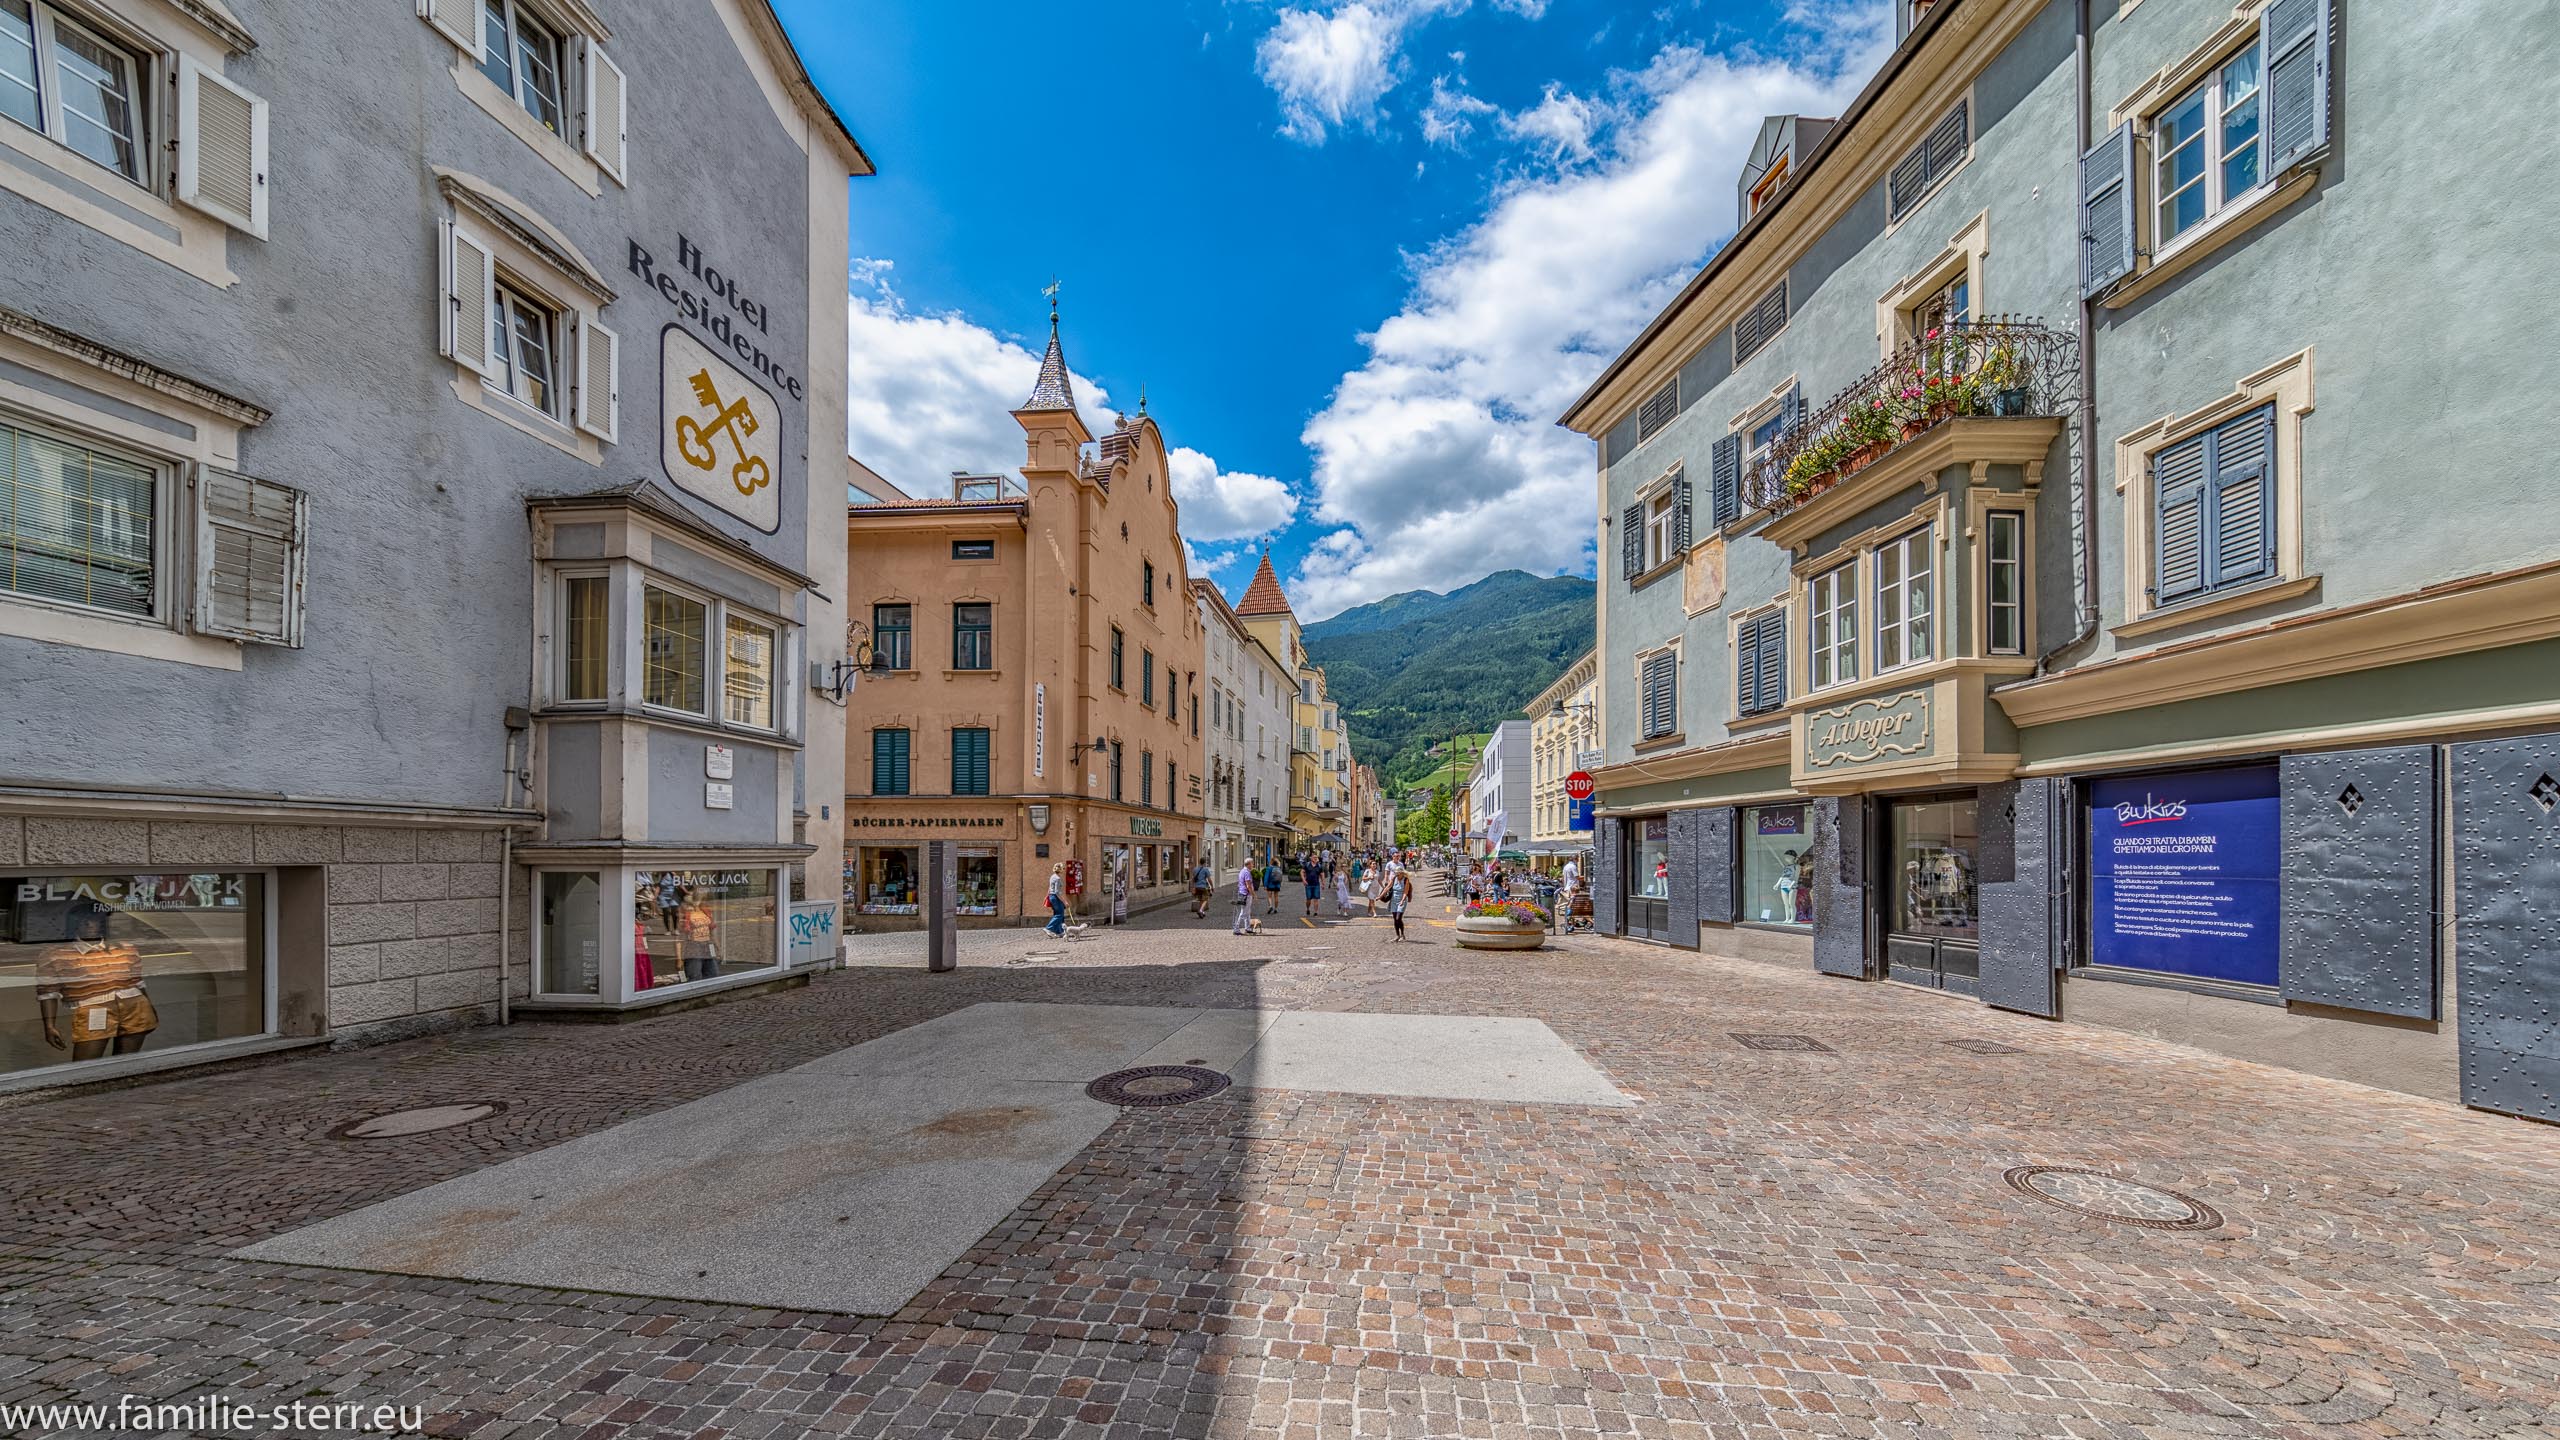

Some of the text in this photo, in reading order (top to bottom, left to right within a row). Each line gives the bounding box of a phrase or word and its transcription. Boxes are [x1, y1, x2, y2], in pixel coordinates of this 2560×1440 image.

[678, 232, 768, 336] Hotel
[627, 236, 802, 402] Residence
[1566, 780, 1592, 790] STOP
[853, 816, 1004, 827] BÜCHER-PAPIERWAREN
[1130, 816, 1162, 836] WEGER
[672, 873, 748, 886] BLACK JACK
[17, 880, 244, 902] BLACK JACK
[94, 902, 131, 913] FASHION
[155, 900, 186, 910] WOMEN
